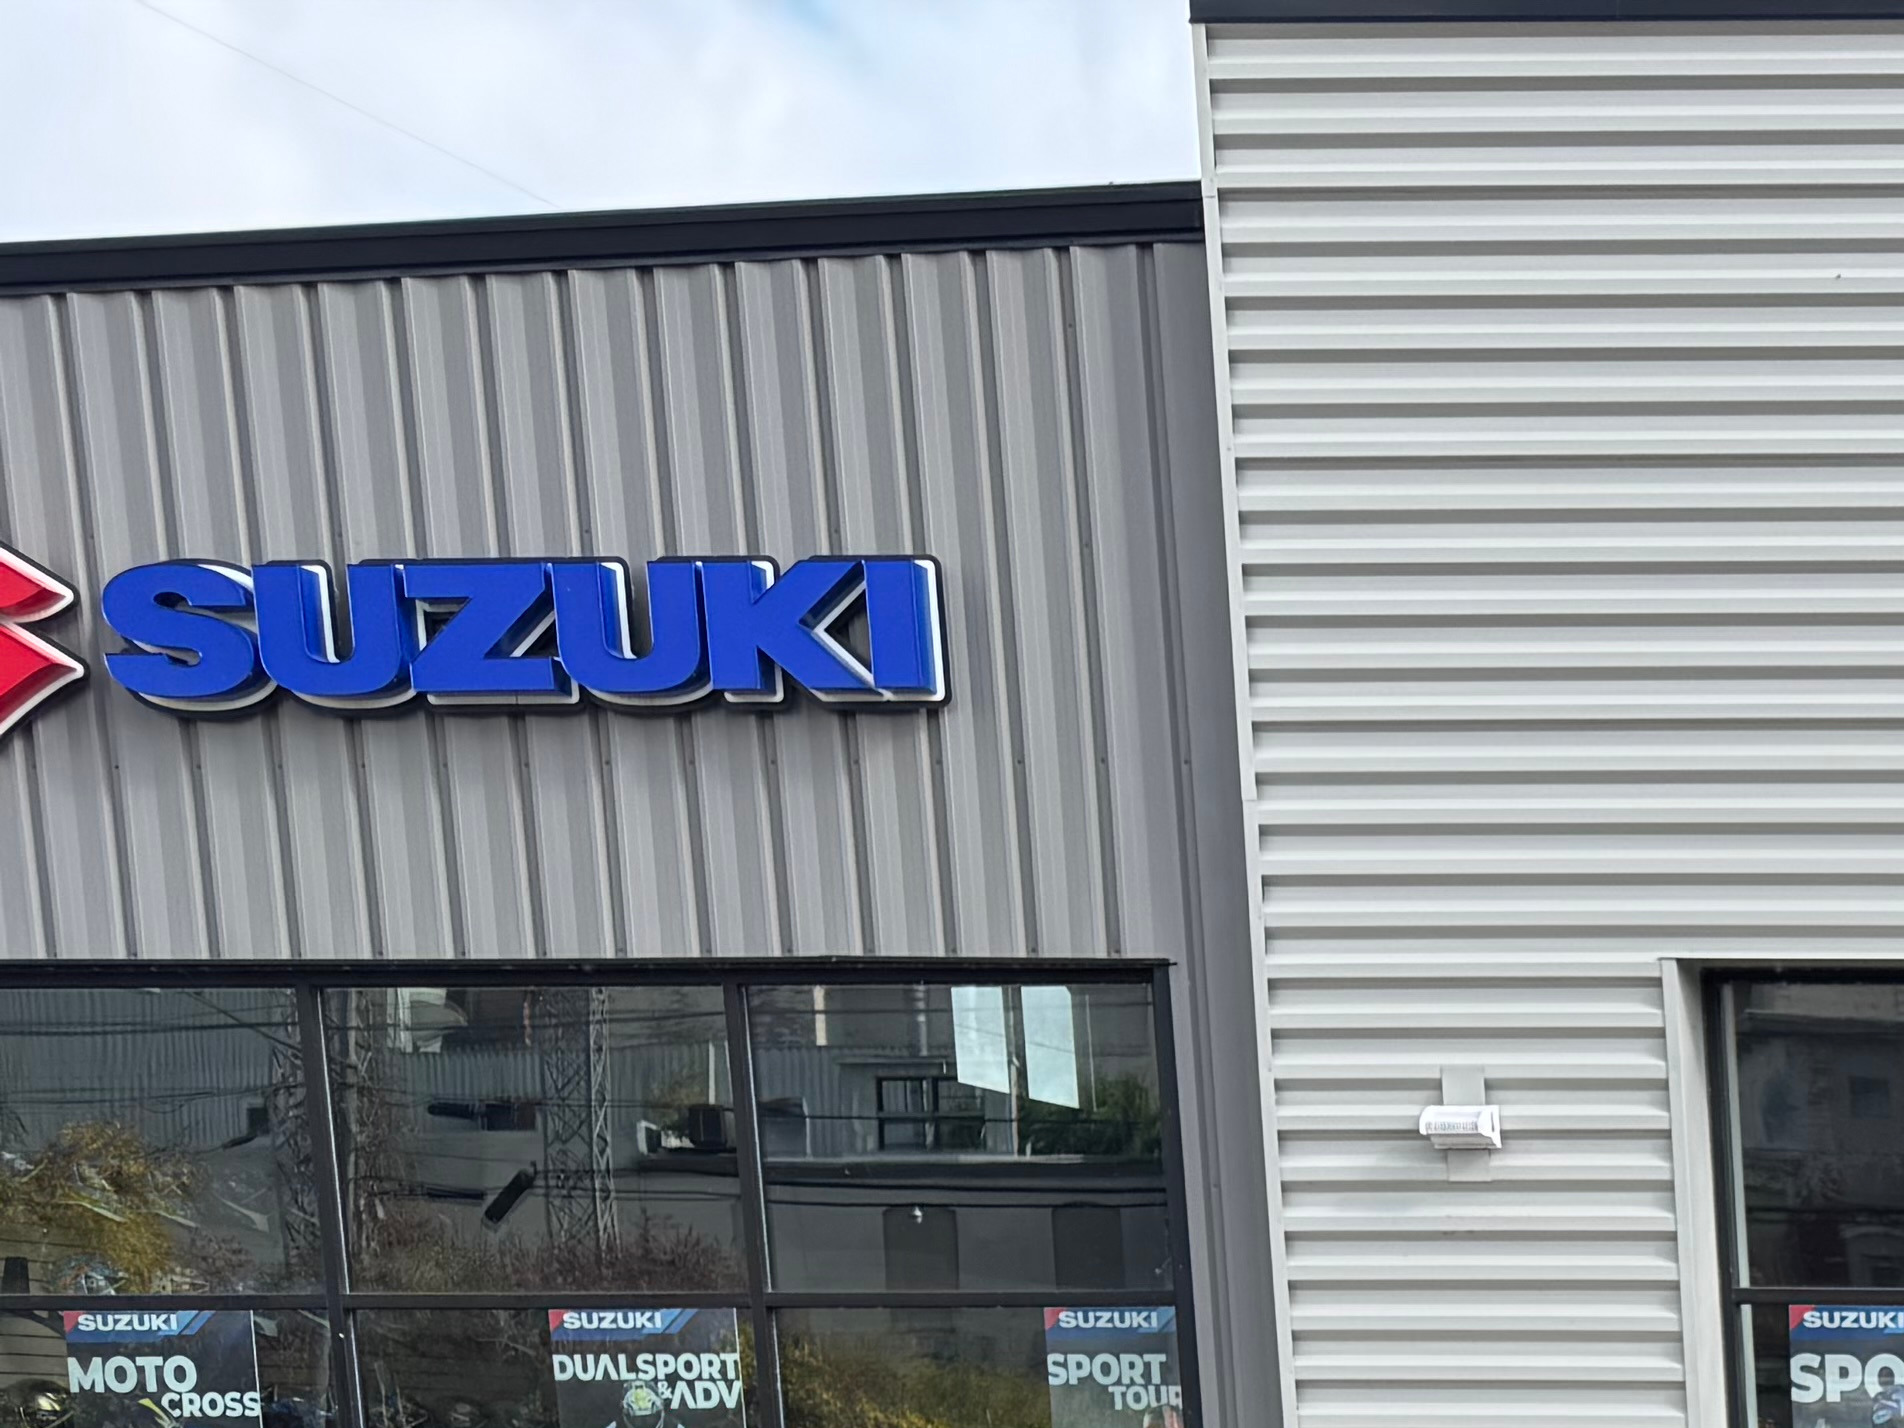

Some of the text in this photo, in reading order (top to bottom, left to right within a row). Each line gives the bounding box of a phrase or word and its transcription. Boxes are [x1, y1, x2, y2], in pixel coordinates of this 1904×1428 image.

[102, 556, 948, 712] SUZUKI
[77, 1313, 179, 1332] SUZUKI
[562, 1311, 662, 1330] SUZUKI
[1058, 1310, 1158, 1329] SUZUKI
[1802, 1311, 1904, 1329] SUZUKI
[67, 1355, 198, 1394] MOTO
[1046, 1353, 1167, 1386] SPORT
[160, 1391, 261, 1418] CROSS
